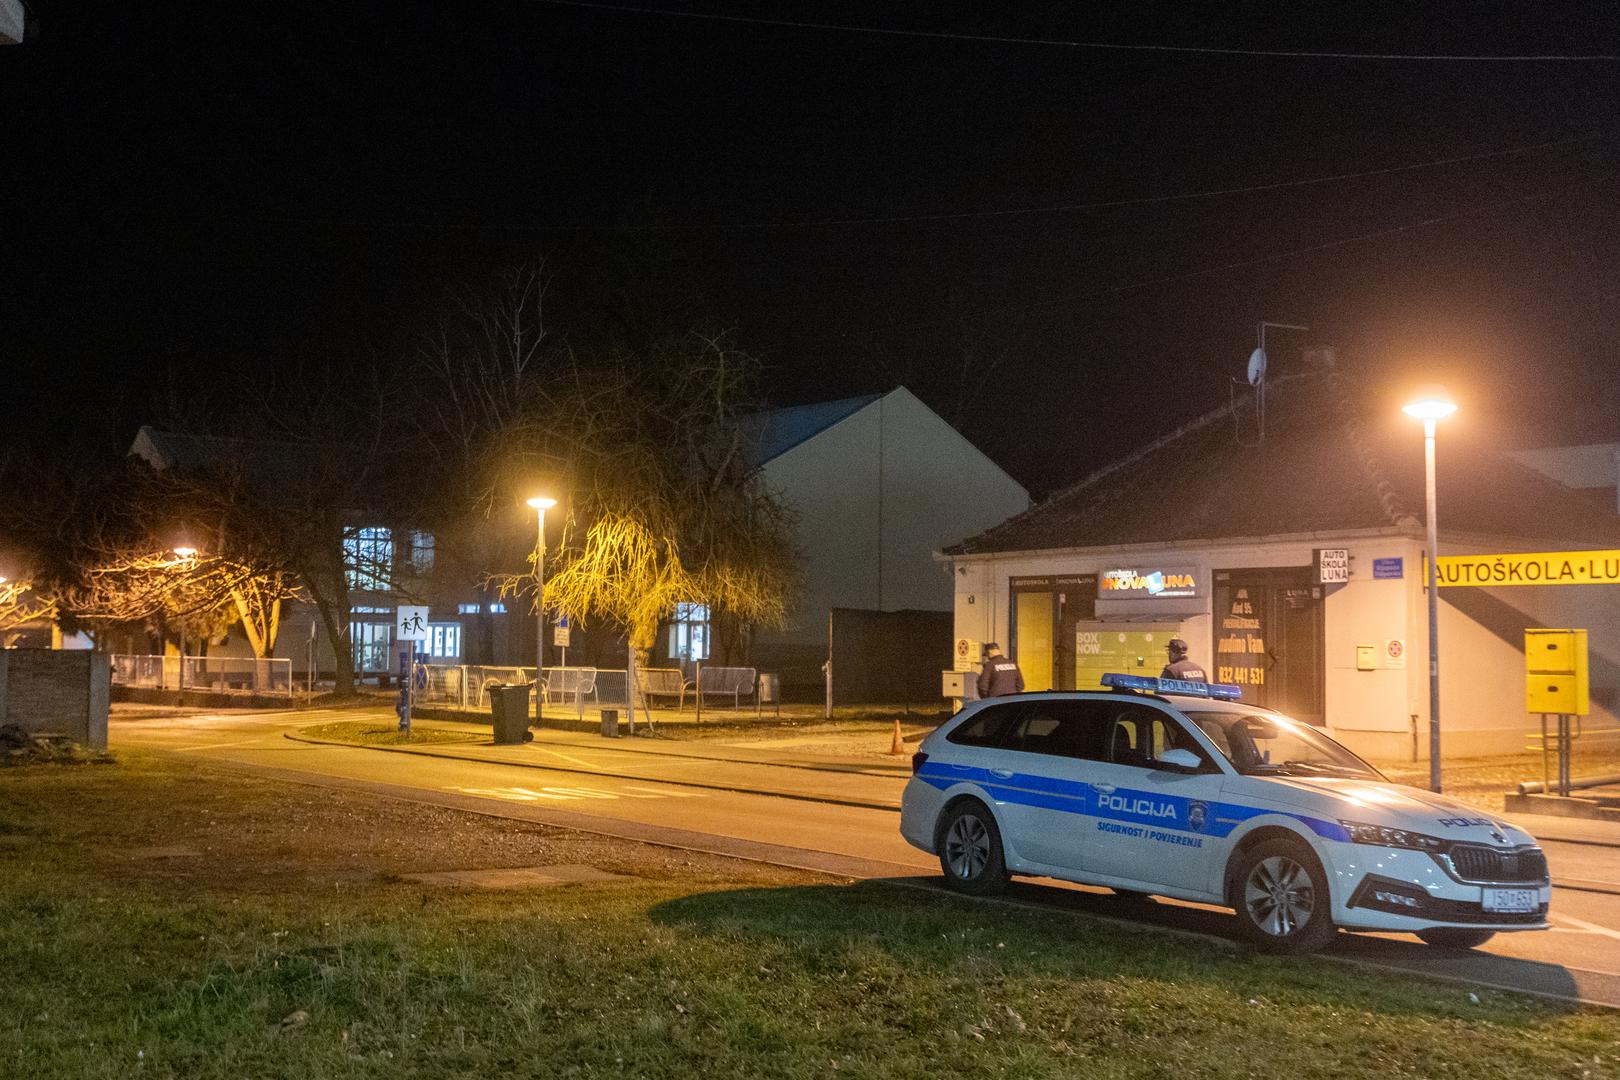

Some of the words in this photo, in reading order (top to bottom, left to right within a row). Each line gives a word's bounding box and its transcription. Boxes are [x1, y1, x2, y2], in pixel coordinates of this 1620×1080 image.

[1324, 550, 1345, 559] AUTO
[1322, 569, 1347, 580] LUNA
[1436, 557, 1575, 583] AUTOŠKOLA
[1076, 632, 1099, 643] BOX
[1076, 643, 1101, 654] NOW
[1219, 666, 1233, 684] 032
[1234, 667, 1248, 684] 441
[1250, 667, 1264, 684] 531
[1161, 679, 1206, 692] POLICIJA
[1098, 794, 1177, 819] POLICIJA
[1097, 821, 1143, 837] SIGURNOST
